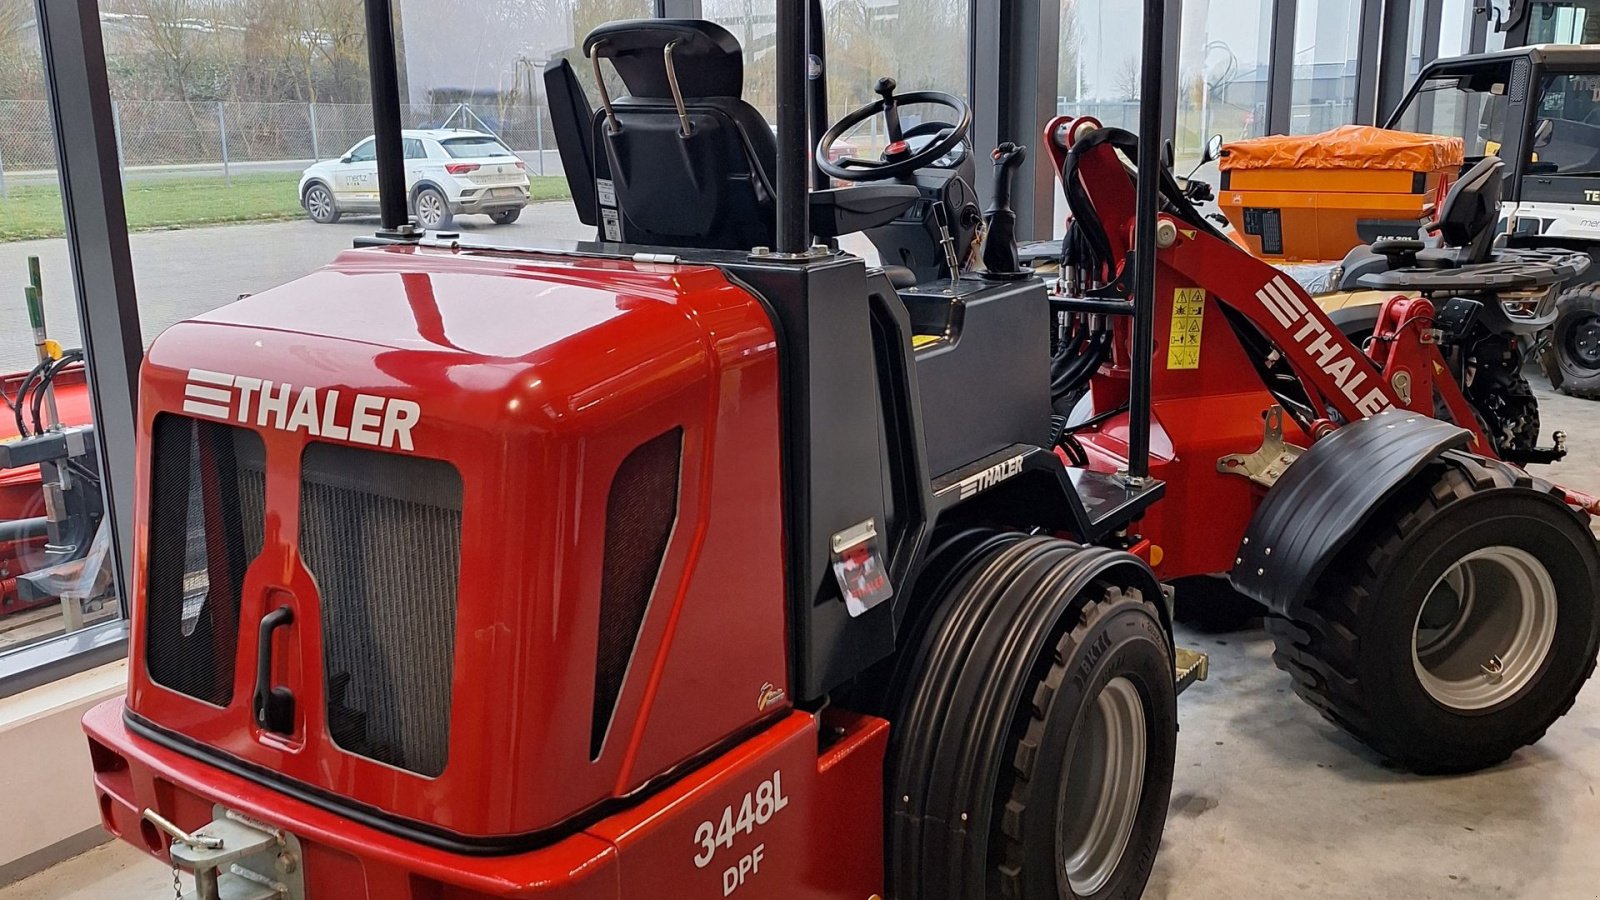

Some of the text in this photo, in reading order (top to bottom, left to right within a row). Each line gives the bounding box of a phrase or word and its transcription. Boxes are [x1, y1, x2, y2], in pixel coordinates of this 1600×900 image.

[1293, 311, 1397, 418] THALE
[233, 375, 421, 451] THALER
[978, 454, 1024, 492] THALER
[694, 769, 789, 868] 3448L
[723, 843, 765, 897] DPF
